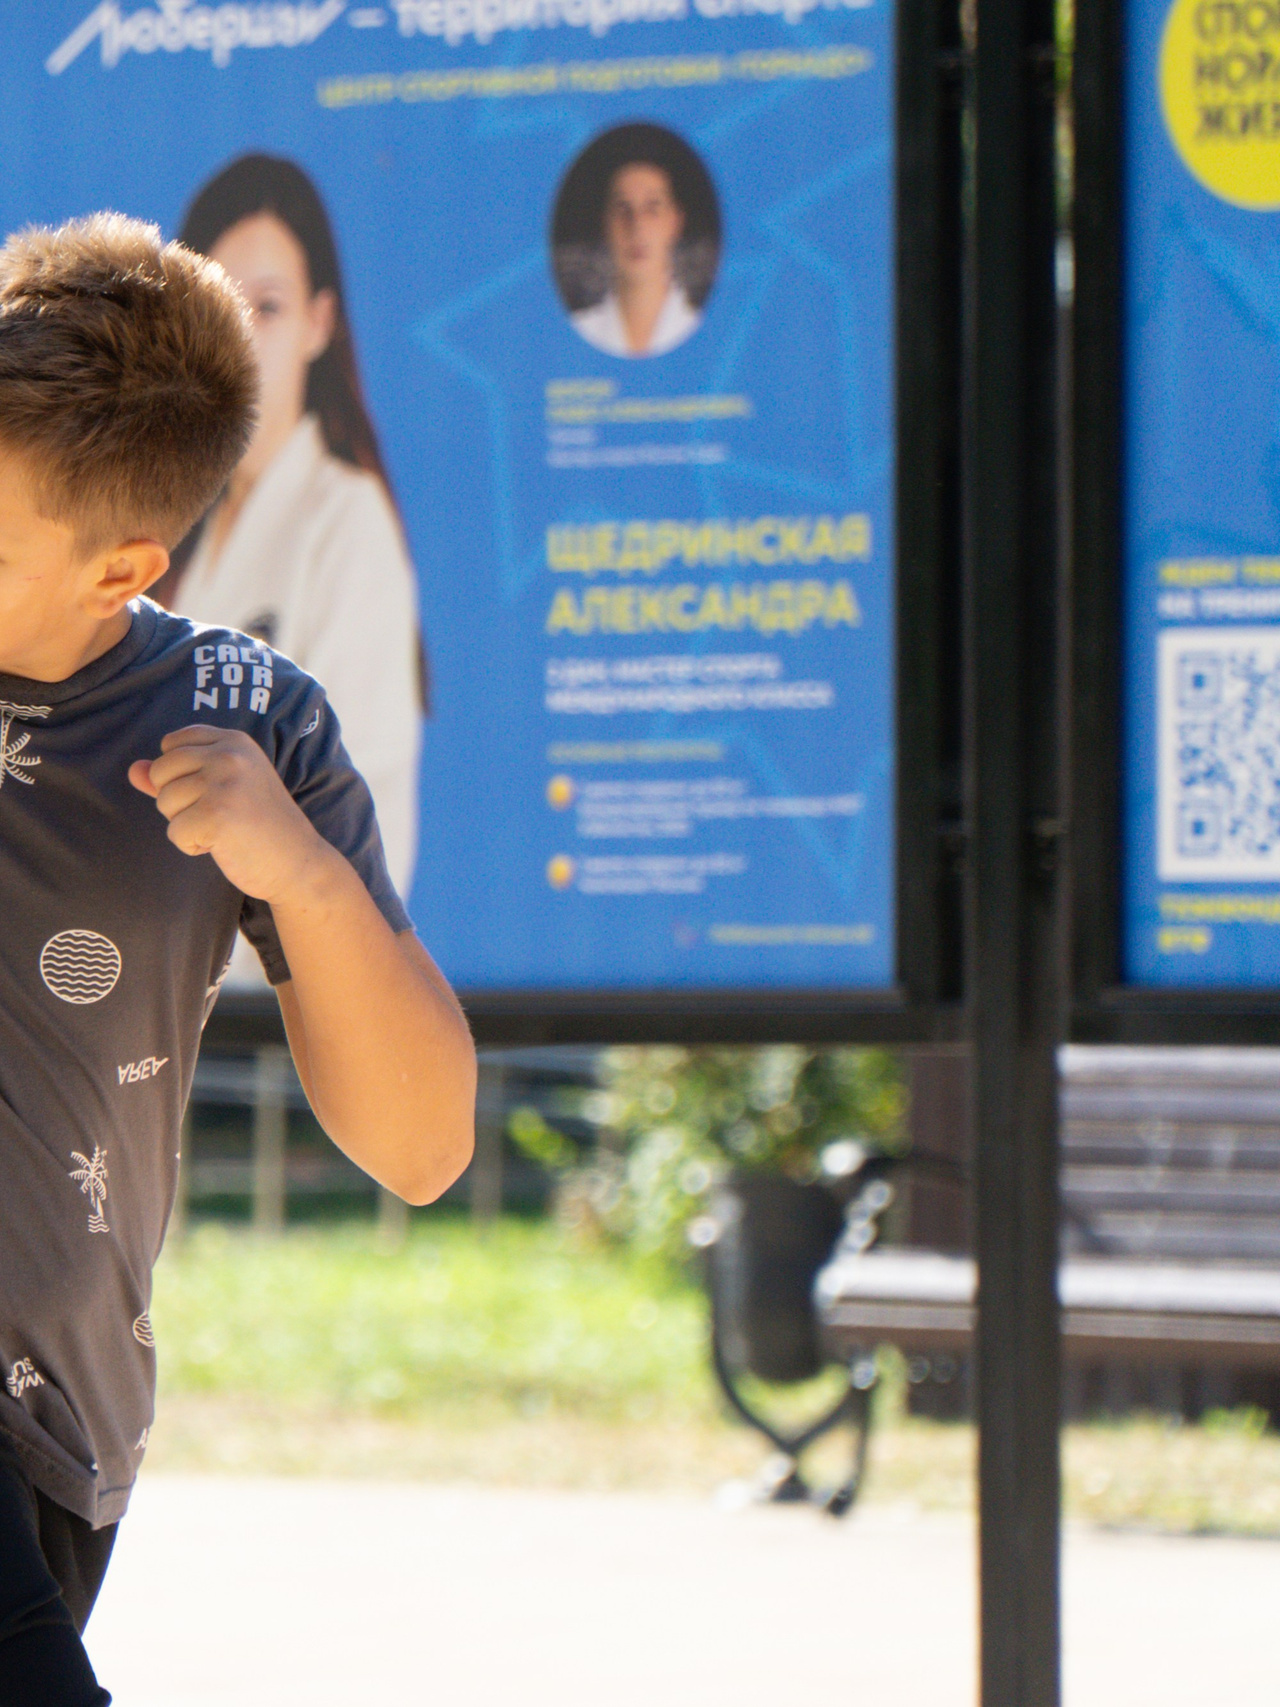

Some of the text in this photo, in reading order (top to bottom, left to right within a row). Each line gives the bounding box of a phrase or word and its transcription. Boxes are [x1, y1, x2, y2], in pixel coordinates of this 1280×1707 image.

[546, 514, 871, 577] ЩЕДРИНСКАЯ
[545, 579, 861, 638] АЛЕКСАНДРА
[193, 643, 273, 668] CALI
[196, 663, 273, 689] FOR
[193, 687, 271, 715] NIA
